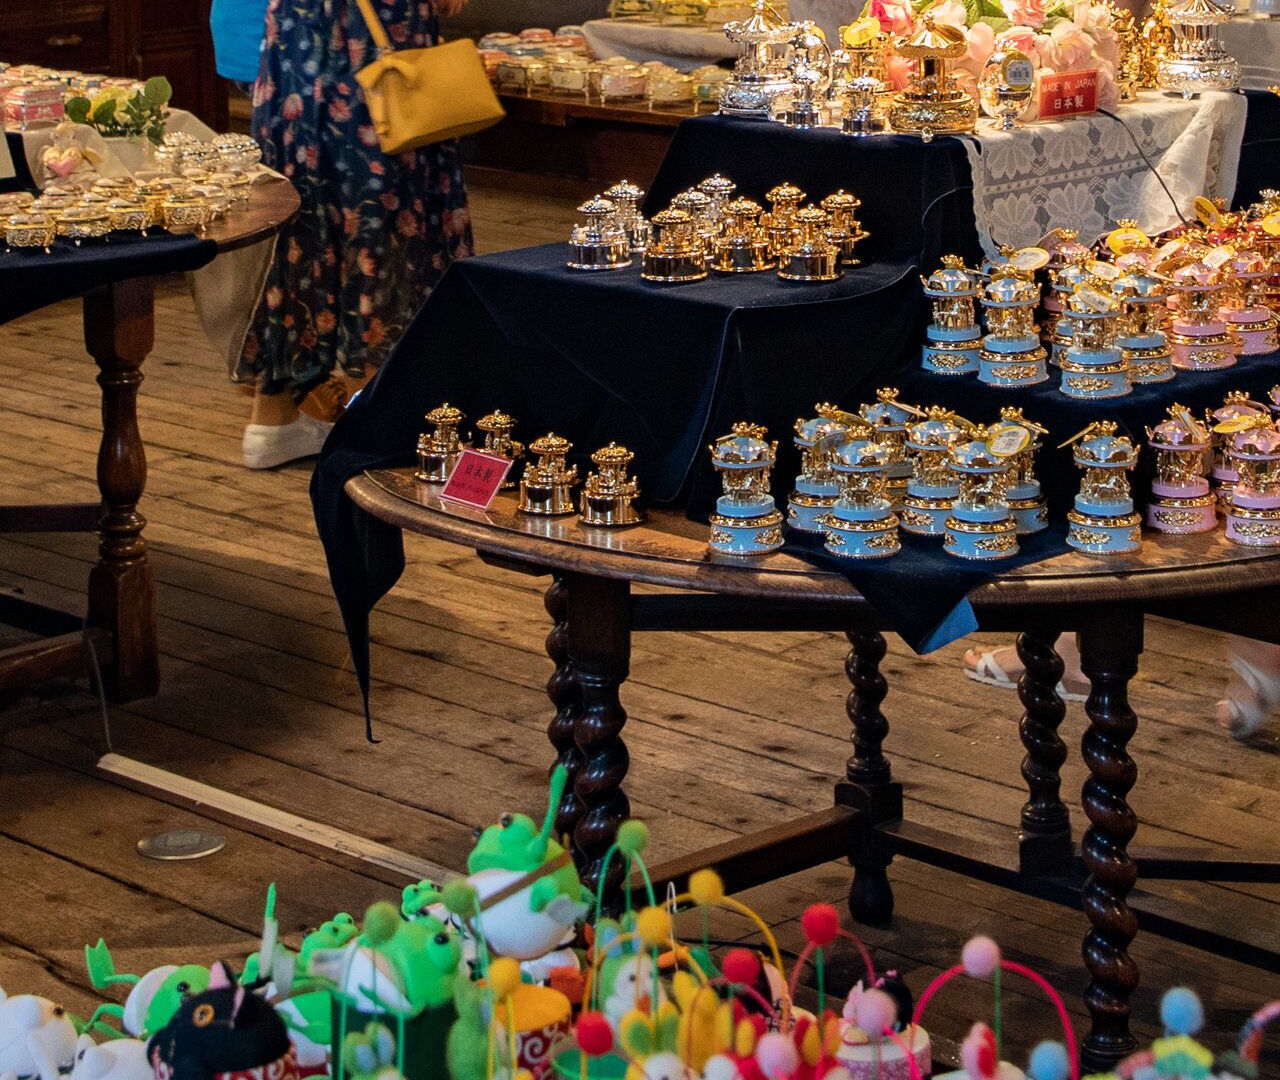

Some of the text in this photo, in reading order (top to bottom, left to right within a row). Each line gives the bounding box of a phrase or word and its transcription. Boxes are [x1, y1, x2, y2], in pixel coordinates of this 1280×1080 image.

[1042, 77, 1096, 93] MADE IN JAPAN
[1054, 94, 1084, 110] 日本製
